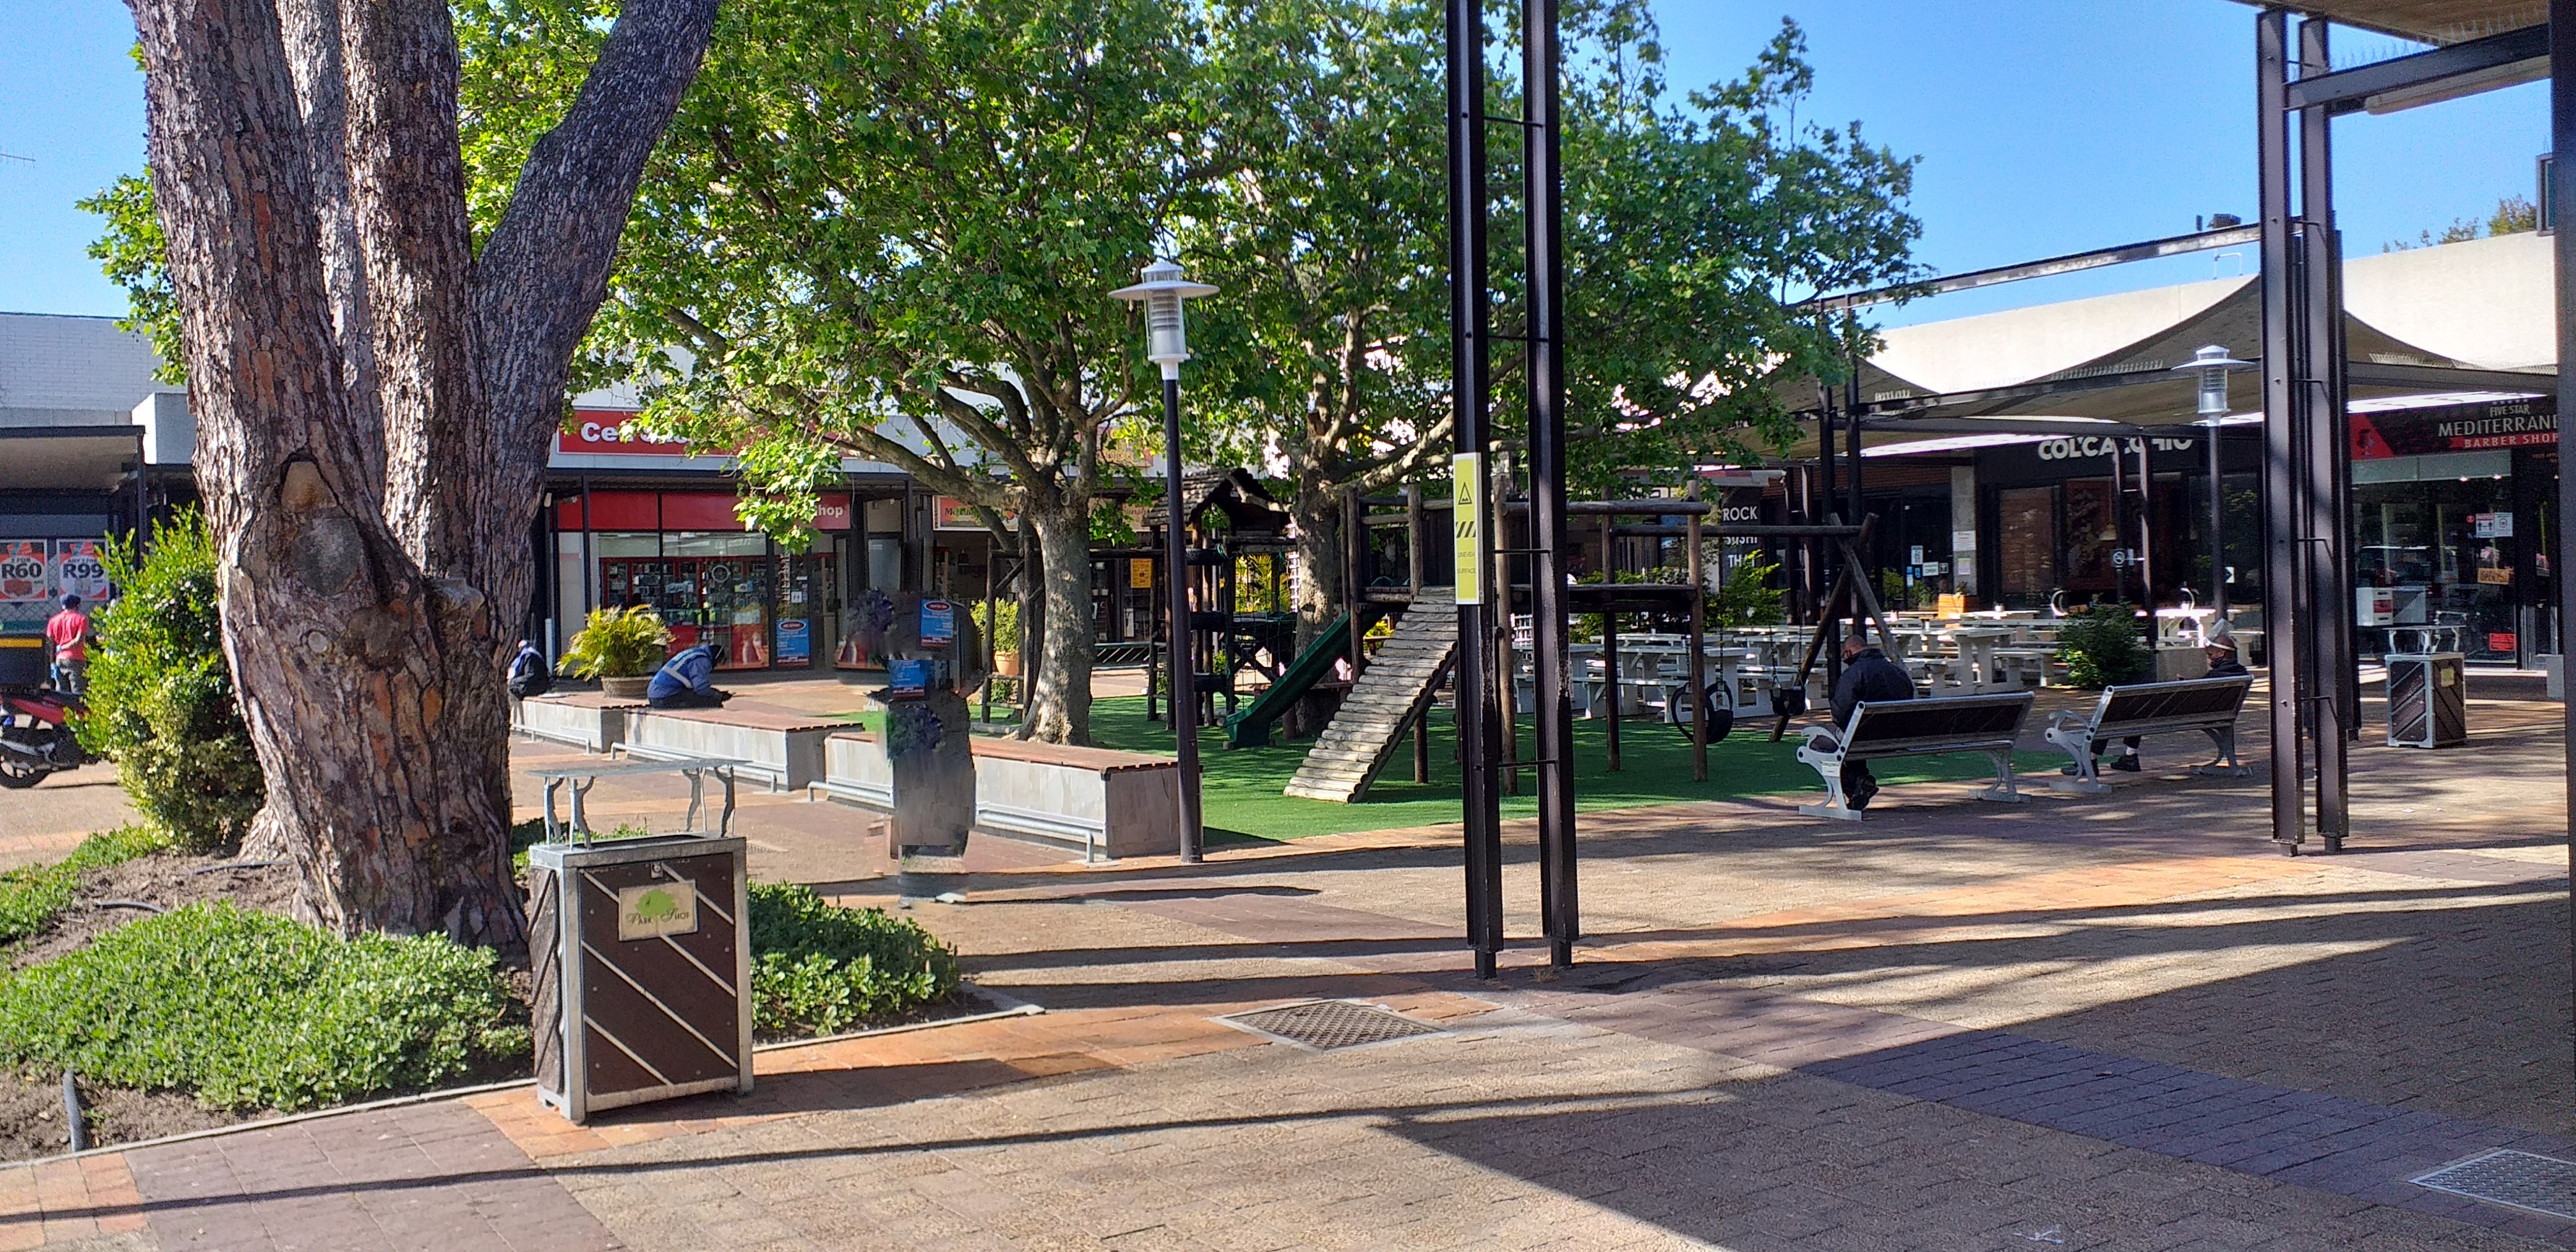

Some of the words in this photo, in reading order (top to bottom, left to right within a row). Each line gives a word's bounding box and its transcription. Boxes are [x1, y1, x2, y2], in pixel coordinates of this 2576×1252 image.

[2490, 407, 2507, 417] FIVE
[2511, 404, 2530, 416] STAR
[2464, 435, 2517, 448] BARBER
[815, 505, 843, 519] hop
[1723, 506, 1758, 521] ROCK
[1, 562, 42, 579] R60
[63, 563, 105, 579] R99
